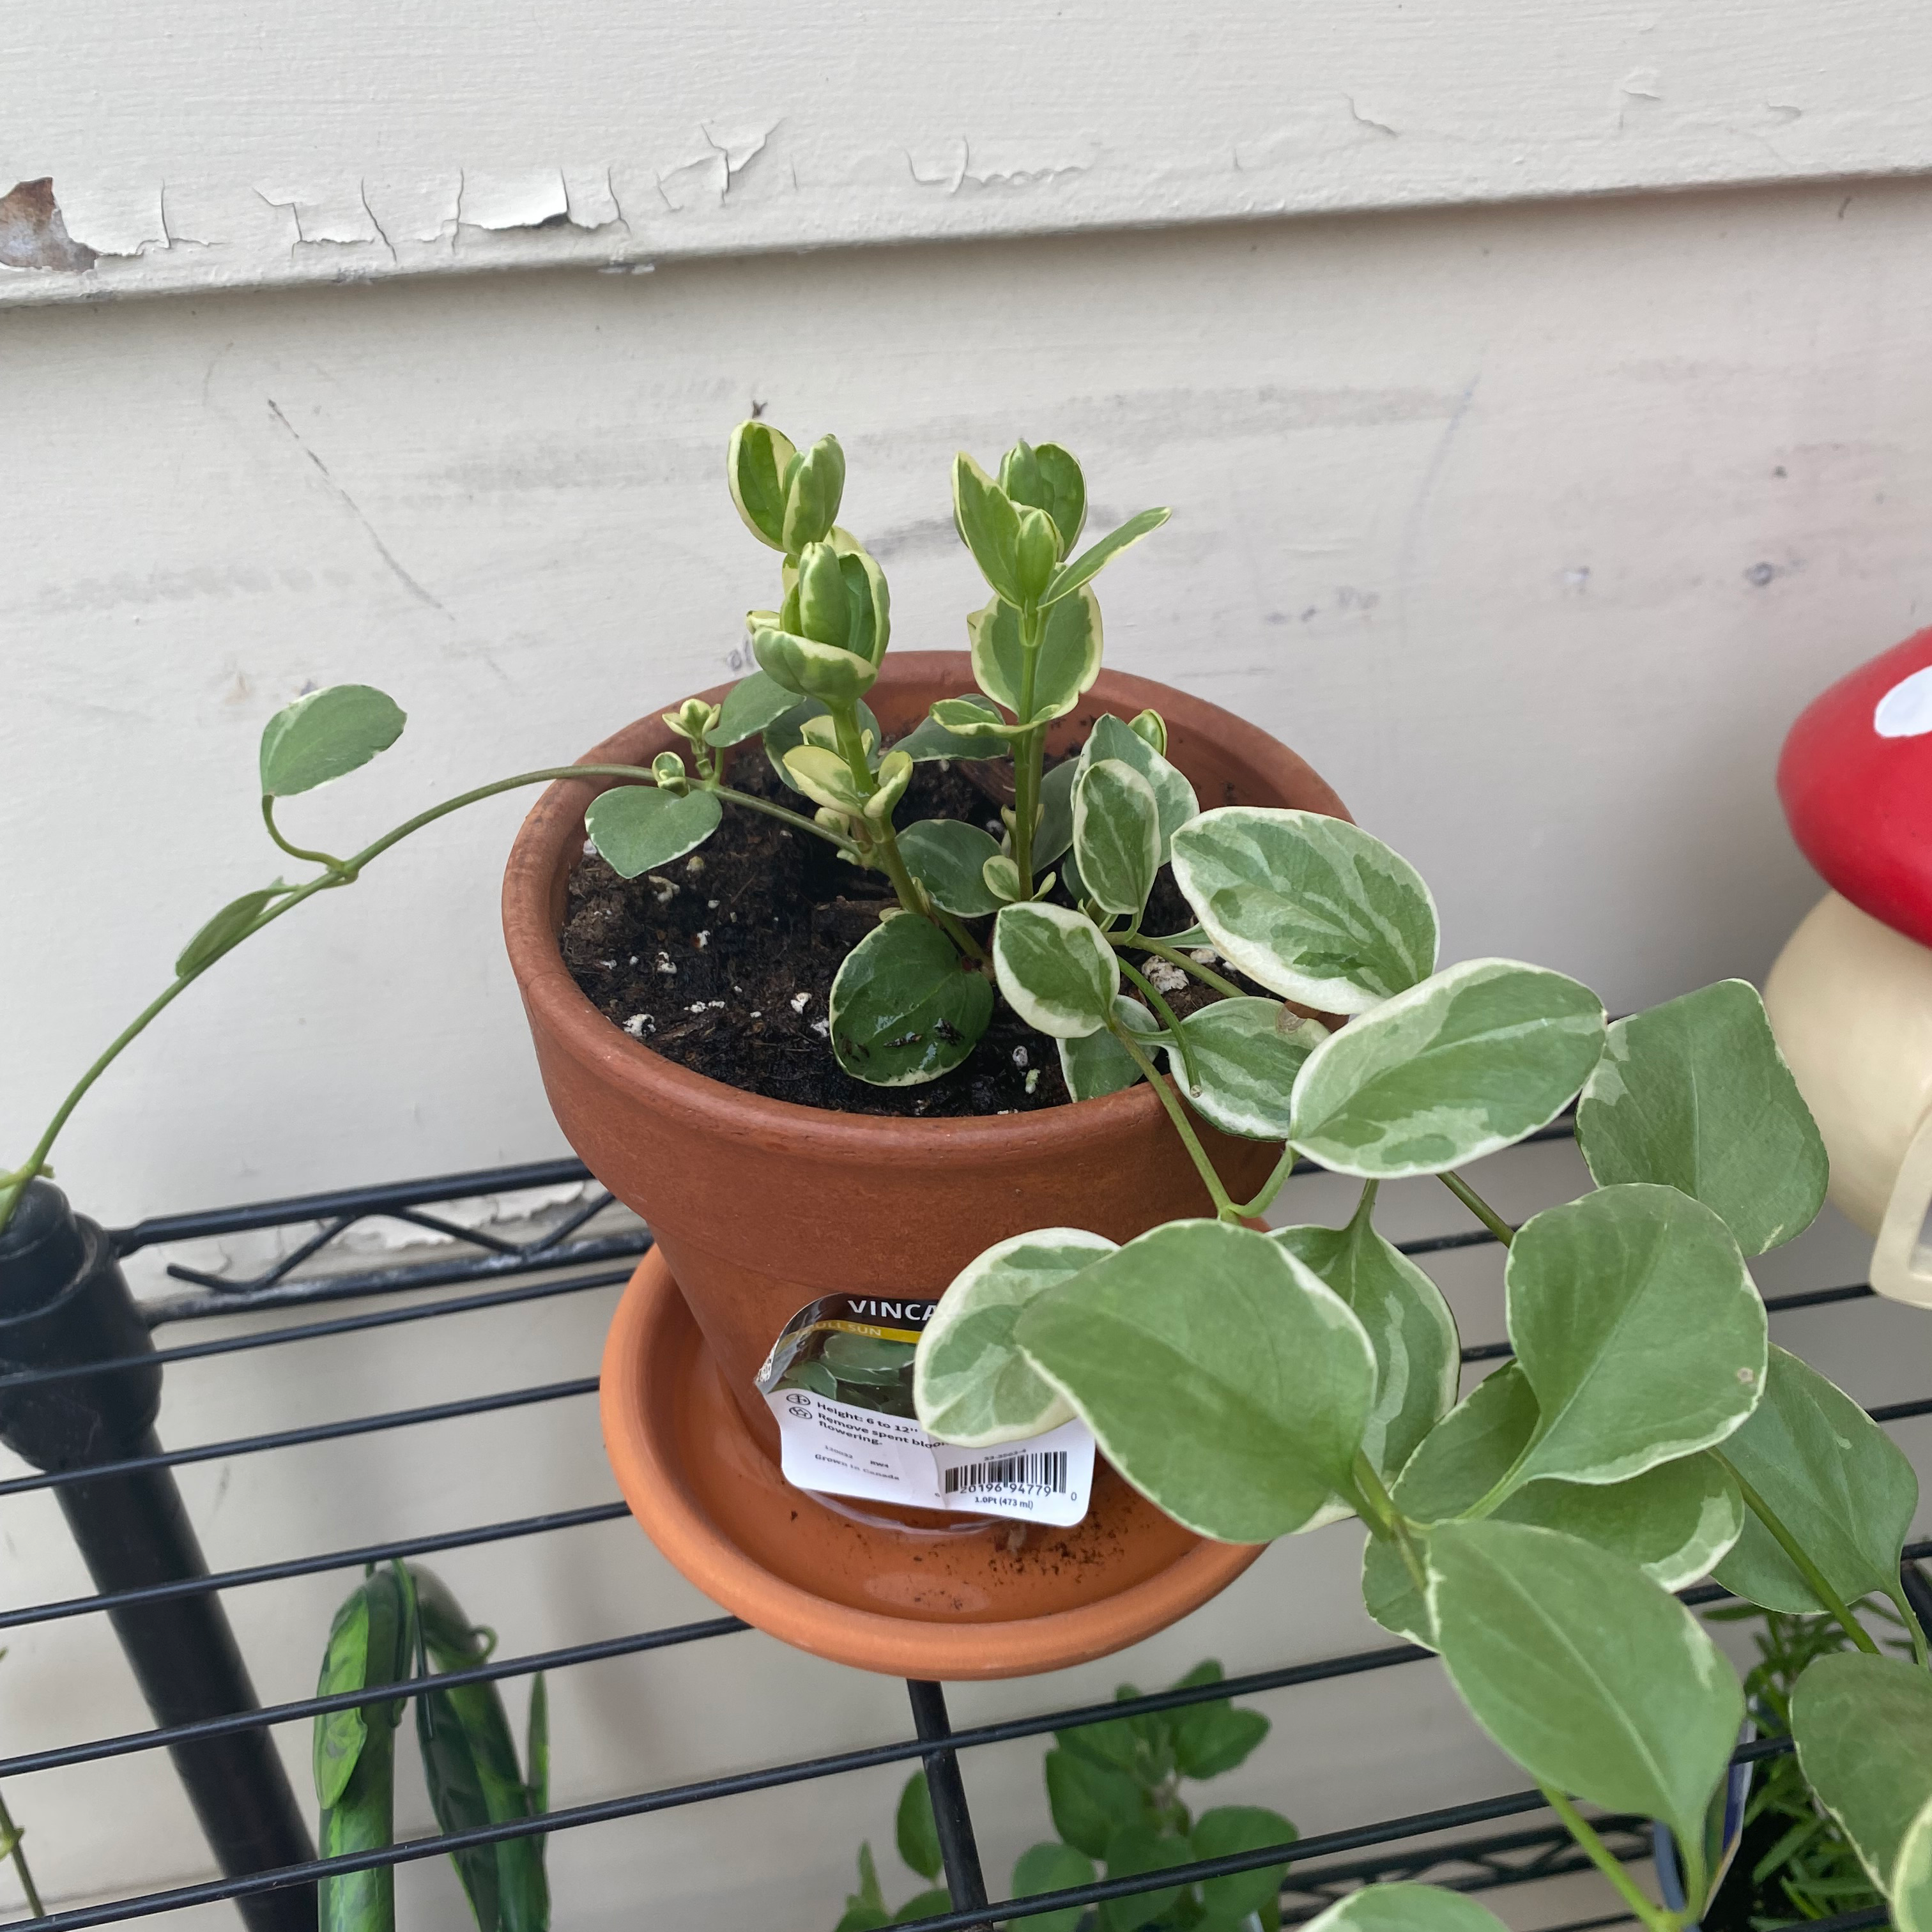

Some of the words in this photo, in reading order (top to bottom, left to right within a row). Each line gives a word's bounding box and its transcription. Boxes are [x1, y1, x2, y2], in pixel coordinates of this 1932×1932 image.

[847, 1300, 937, 1321] VINCA
[848, 1323, 882, 1336] SUN
[817, 1402, 863, 1422] Height:
[877, 1420, 891, 1429] to
[818, 1412, 869, 1434] Remove
[872, 1430, 909, 1444] spent
[819, 1420, 883, 1445] flowering.
[815, 1454, 848, 1467] Grown
[862, 1469, 900, 1480] Canada
[960, 1483, 1002, 1494] 20196
[1009, 1483, 1052, 1497] 94779
[1071, 1492, 1077, 1501] 0
[975, 1496, 997, 1505] 1.0Pt
[999, 1498, 1018, 1506] (473
[1019, 1499, 1033, 1510] ml)
